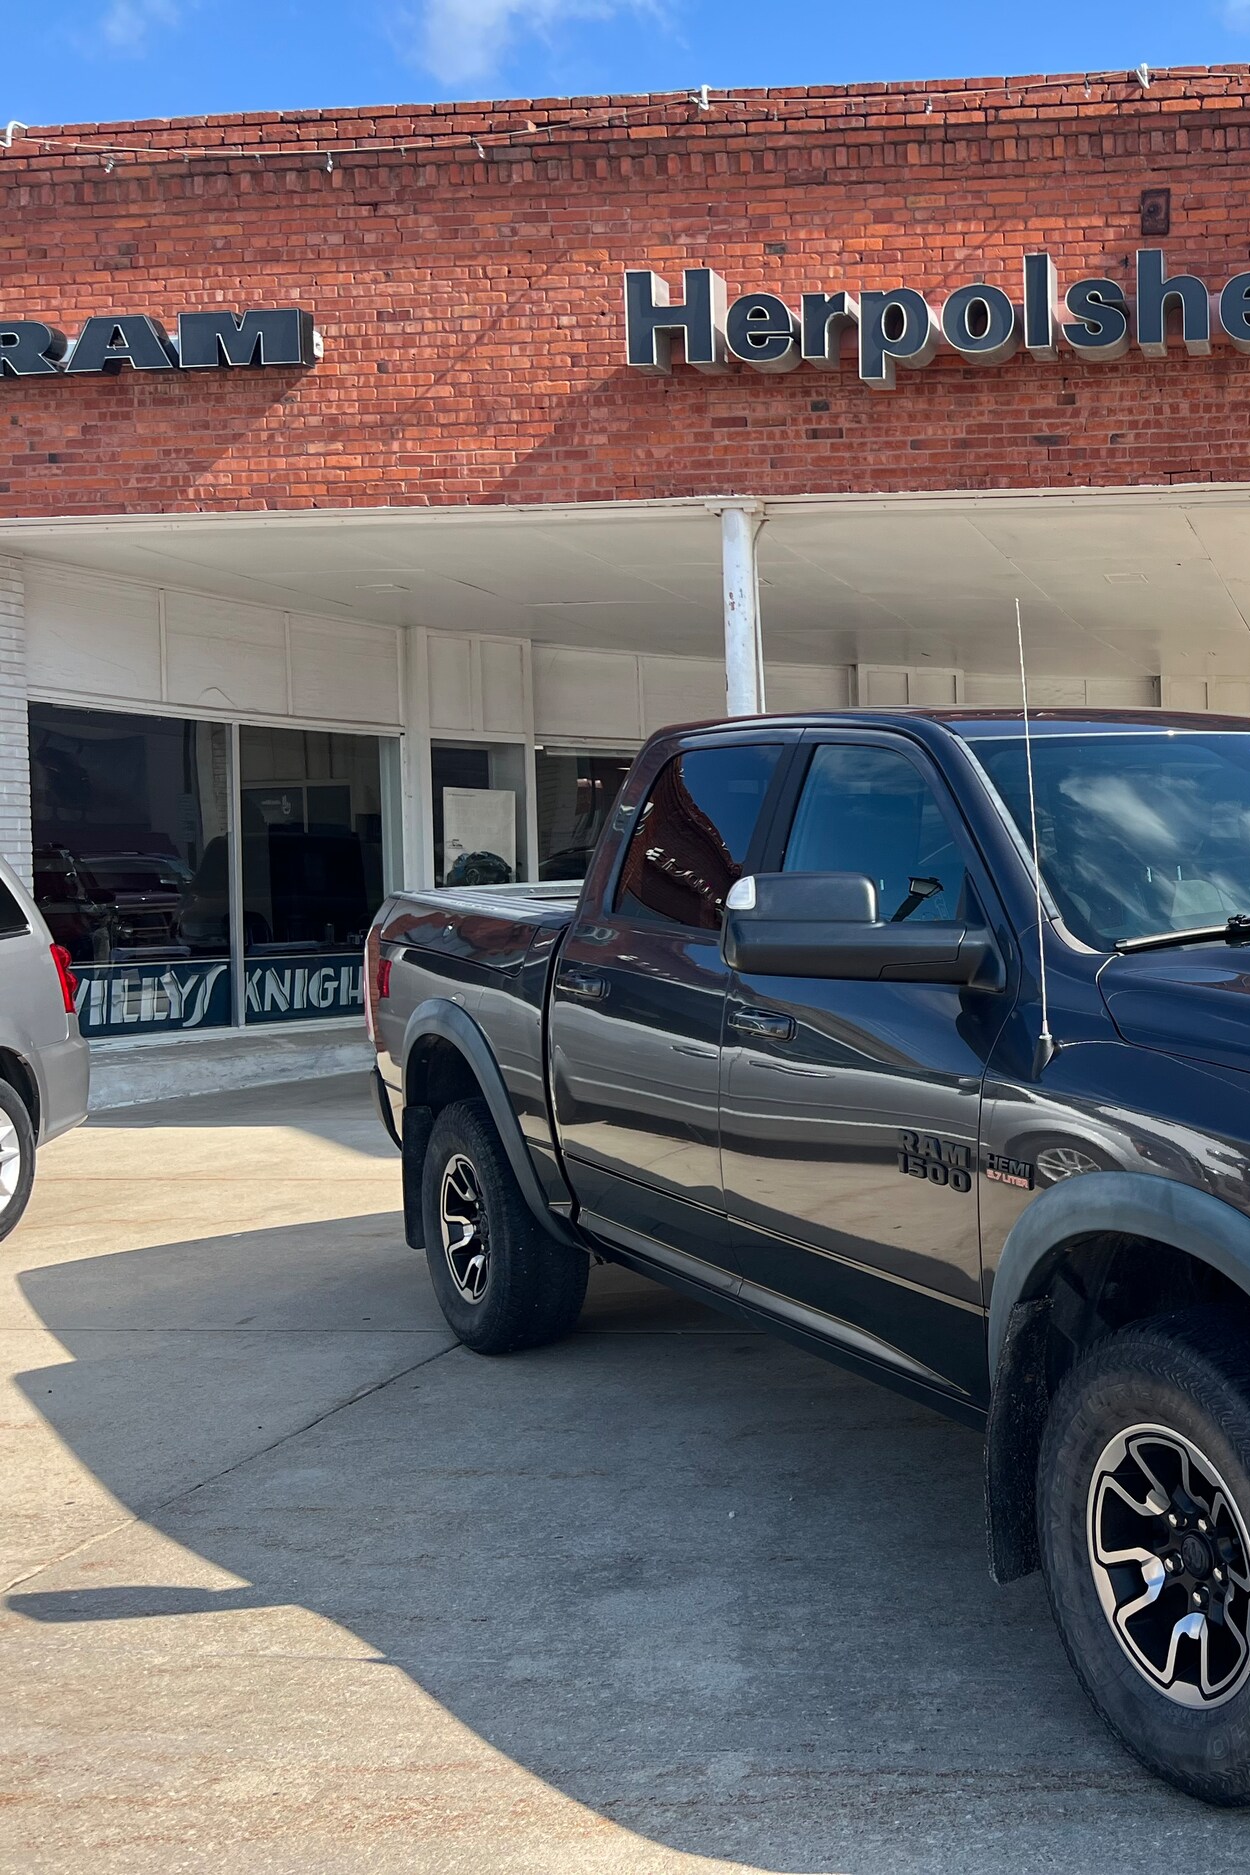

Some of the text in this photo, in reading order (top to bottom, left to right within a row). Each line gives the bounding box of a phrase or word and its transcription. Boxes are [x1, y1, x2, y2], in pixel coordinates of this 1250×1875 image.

[0, 308, 308, 377] RAM
[245, 965, 364, 1013] KNIGH
[897, 1128, 971, 1168] RAM
[986, 1153, 1034, 1178] HEMI
[897, 1152, 972, 1193] 1500
[986, 1168, 1030, 1190] 5.7 LITER
